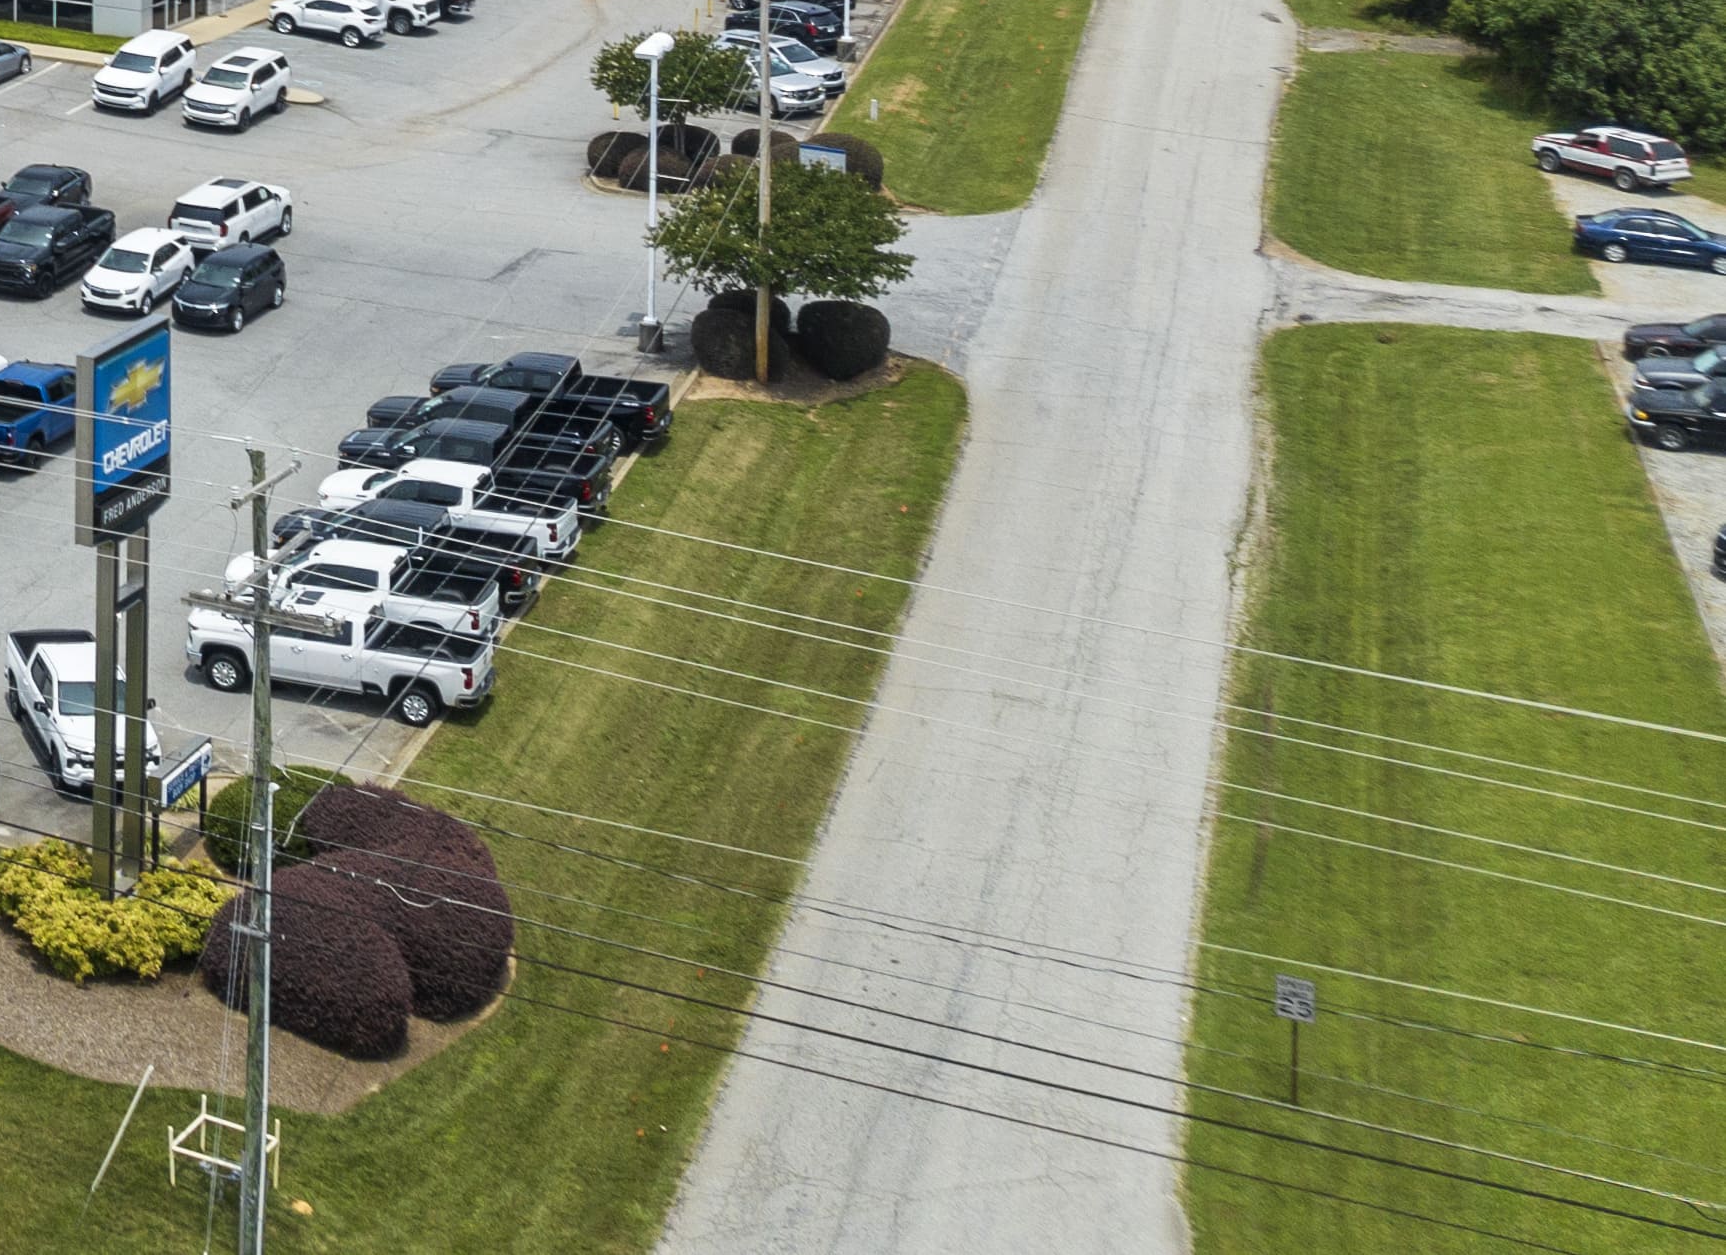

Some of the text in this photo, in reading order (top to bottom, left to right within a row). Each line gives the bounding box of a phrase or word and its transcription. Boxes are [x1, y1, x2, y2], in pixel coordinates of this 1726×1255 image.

[103, 419, 168, 475] CHEVROLET
[104, 477, 167, 525] FRED ANDERSON
